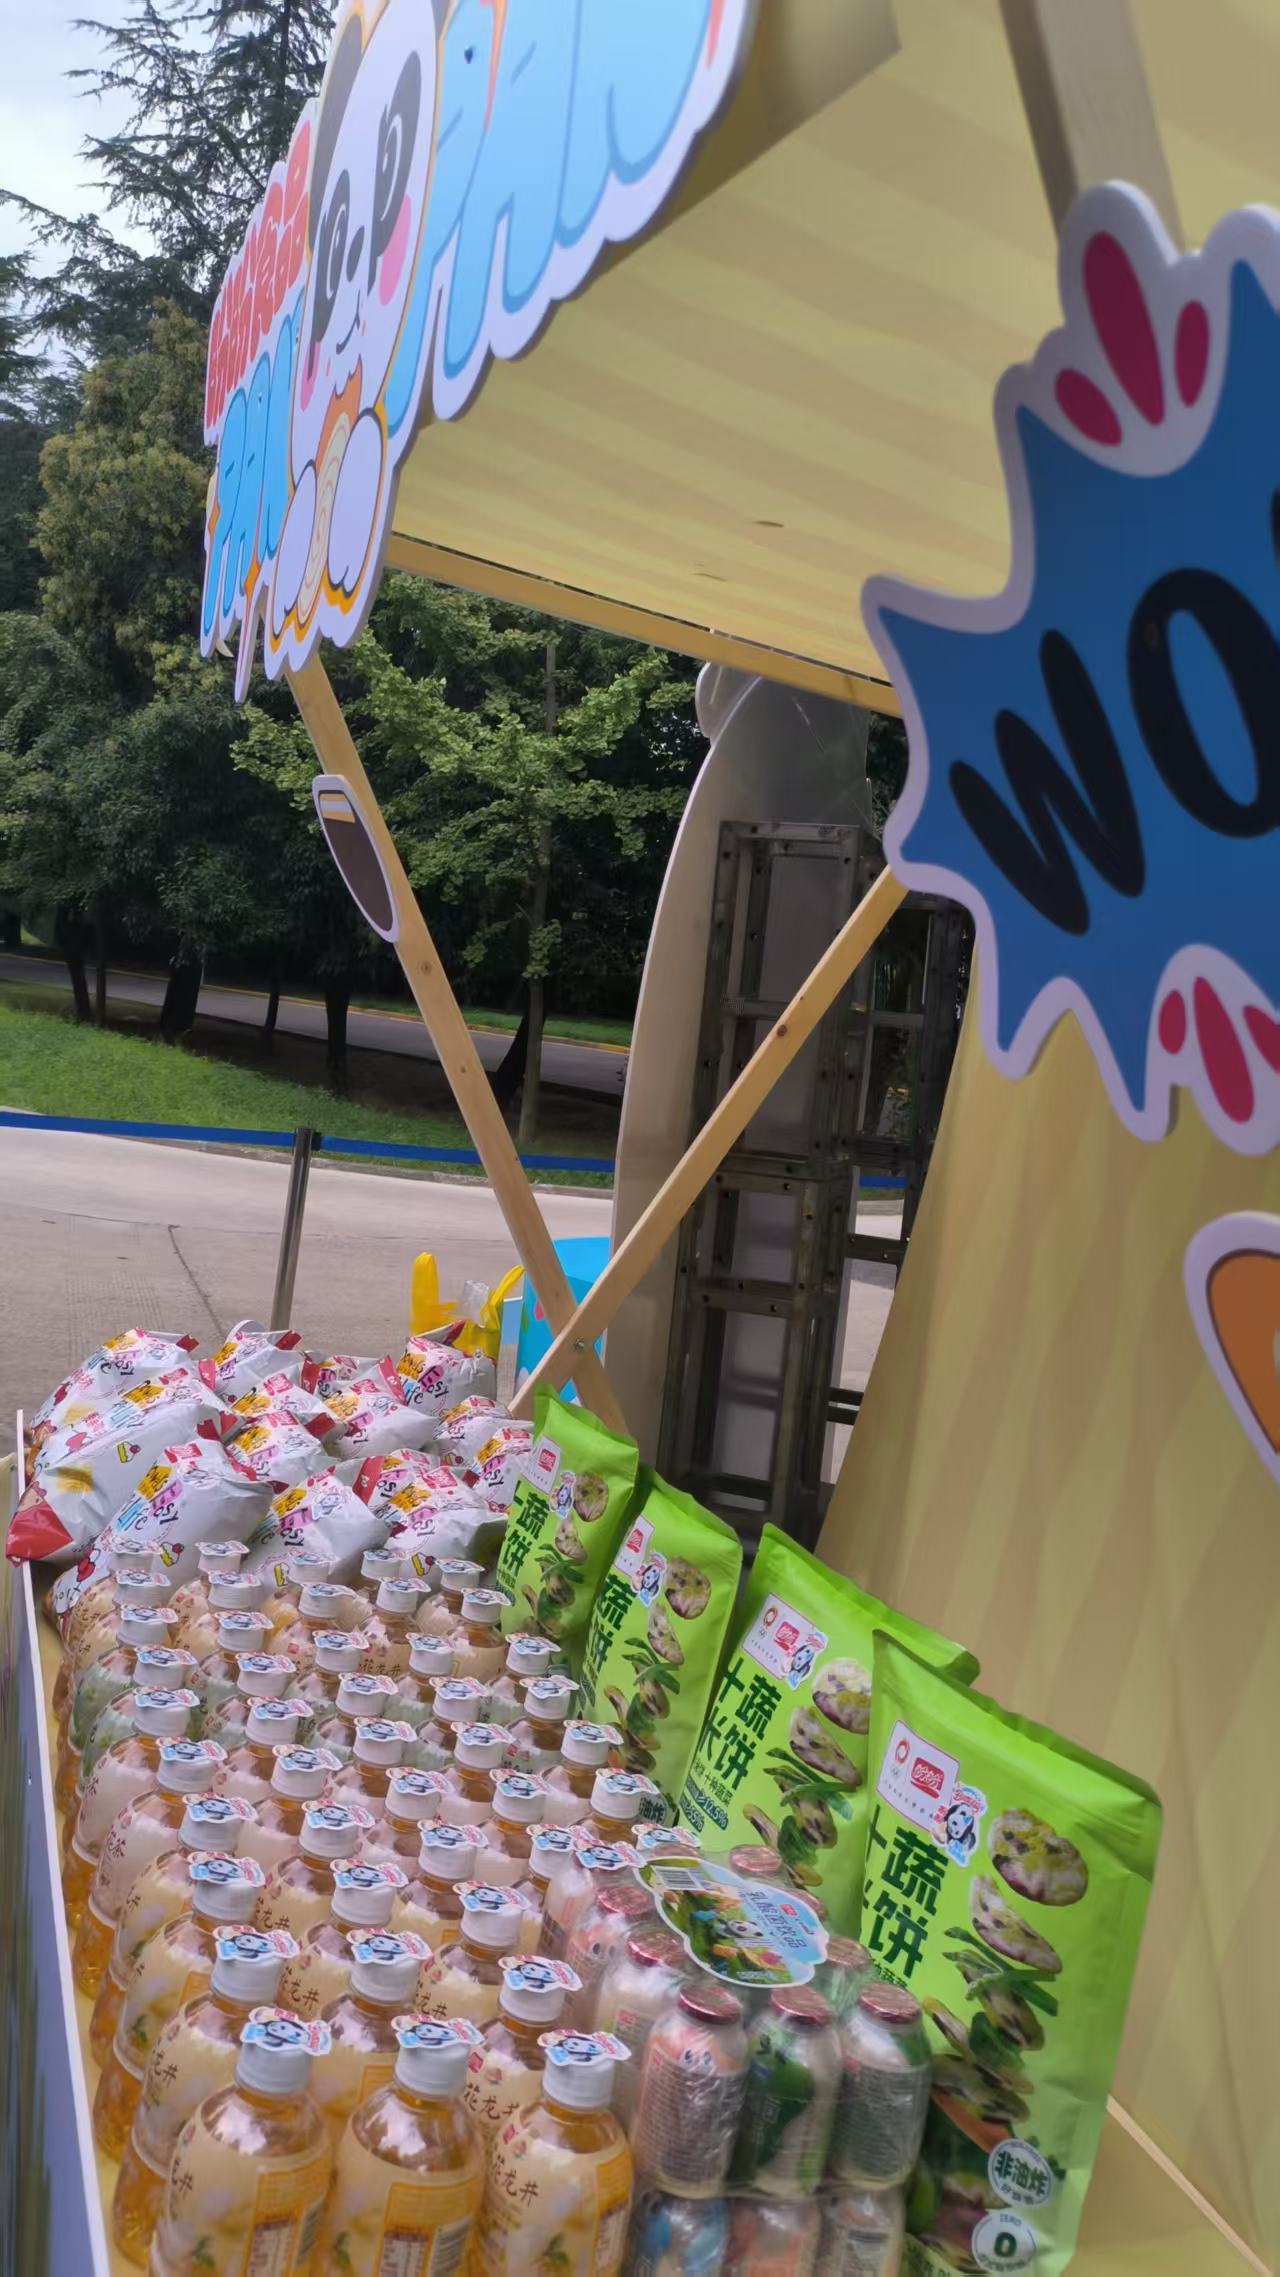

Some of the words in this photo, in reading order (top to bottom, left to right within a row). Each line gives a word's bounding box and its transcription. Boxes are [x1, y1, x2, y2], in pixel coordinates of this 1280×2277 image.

[948, 487, 1280, 937] WO
[722, 1656, 783, 1742] 十蔬
[637, 1795, 665, 1824] 油炸
[864, 1879, 929, 1980] 饼
[994, 2150, 1050, 2198] 非油炸
